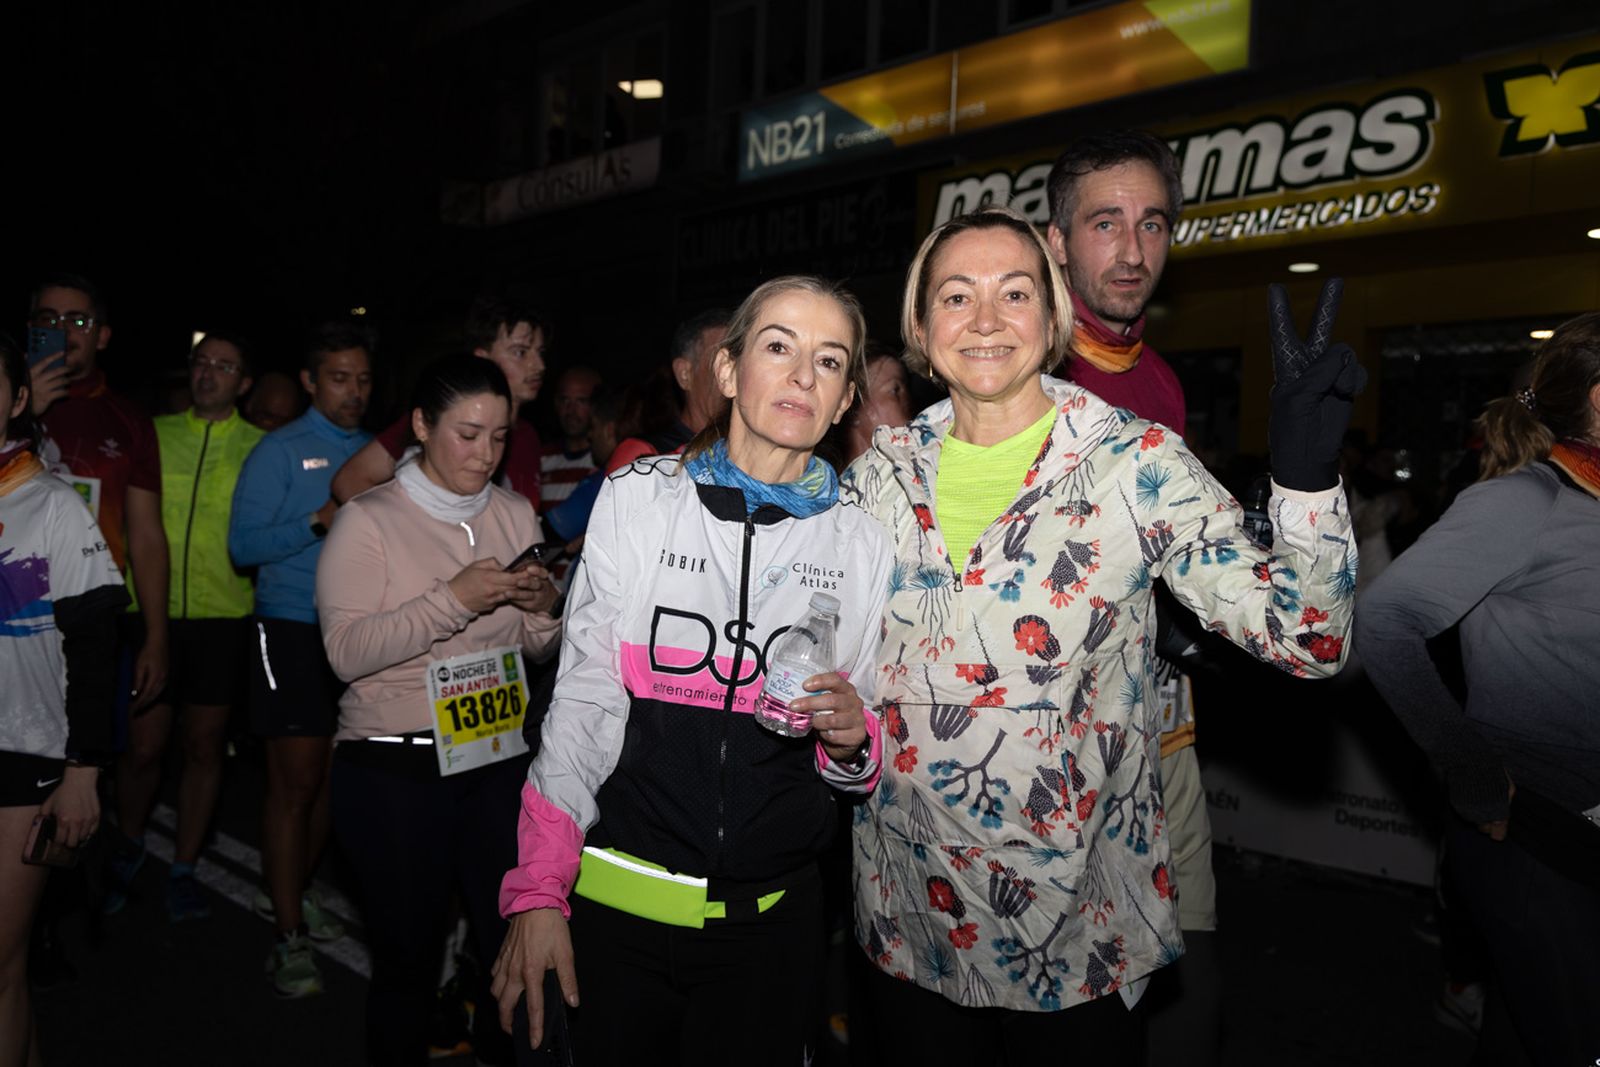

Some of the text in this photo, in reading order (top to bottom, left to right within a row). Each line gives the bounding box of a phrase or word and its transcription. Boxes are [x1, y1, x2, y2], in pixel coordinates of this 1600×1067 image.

[747, 111, 827, 171] NB21
[1170, 182, 1440, 248] UPERMERCADOS
[792, 562, 845, 579] Clínica
[799, 575, 838, 591] Atlas
[452, 664, 485, 681] NOCHE
[487, 661, 498, 672] DE
[440, 683, 464, 698] SAN
[652, 681, 747, 706] etrenamiento
[446, 685, 521, 731] 13826
[1204, 788, 1240, 811] AÉN
[1326, 790, 1400, 813] atronato
[1334, 807, 1421, 837] Deportes
